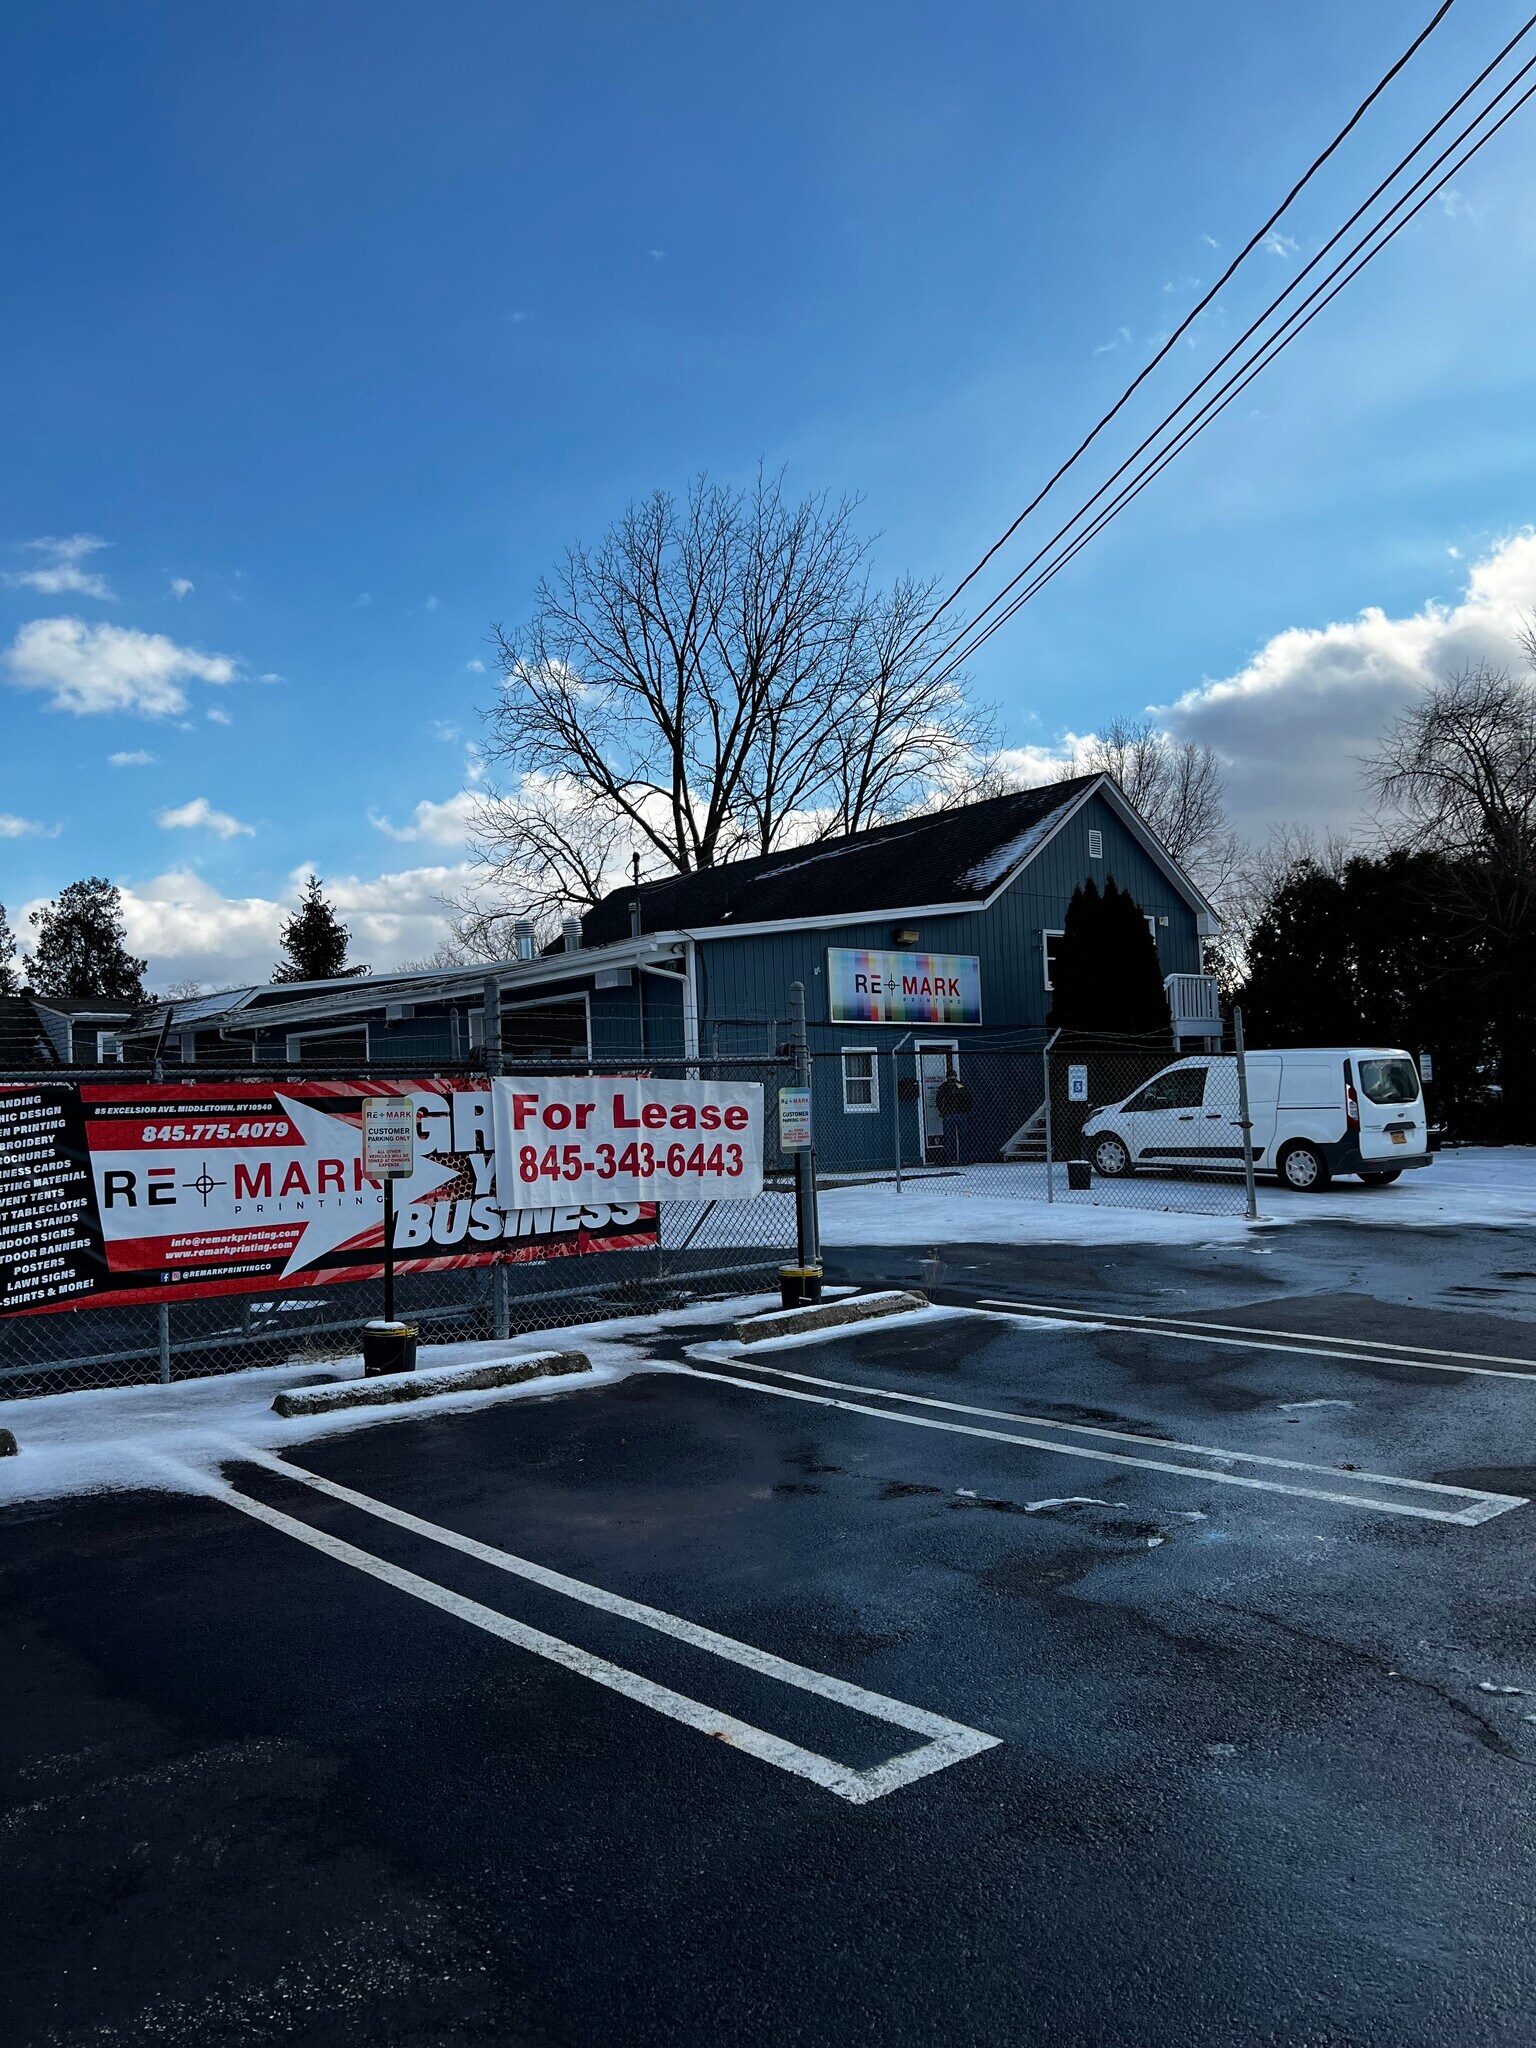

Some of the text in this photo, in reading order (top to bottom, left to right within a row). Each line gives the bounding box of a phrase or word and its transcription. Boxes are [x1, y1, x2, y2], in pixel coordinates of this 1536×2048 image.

[855, 974, 960, 997] RE MARK
[20, 1106, 62, 1120] DESIGN
[95, 1107, 106, 1115] 85
[107, 1106, 157, 1115] EXCELSIOR
[157, 1105, 177, 1113] AVE.
[178, 1104, 235, 1113] MIDDLETOWN,
[248, 1103, 273, 1111] 10940
[366, 1111, 378, 1119] RE
[512, 1093, 749, 1131] For Lease
[13, 1119, 66, 1135] PRINTING
[142, 1121, 289, 1142] 845.775.4079
[368, 1127, 410, 1135] CUSTOMER
[33, 1160, 71, 1174] CARDS
[519, 1142, 743, 1183] 845-343-6443
[33, 1171, 87, 1188] MATERIAL
[104, 1158, 382, 1209] RE MARK
[30, 1188, 65, 1202] TENTS
[11, 1198, 88, 1219] TABLECLOTHS
[235, 1195, 383, 1214] PRINTING
[35, 1213, 79, 1229] STANDS
[41, 1227, 75, 1242] SIGNS
[170, 1230, 300, 1247] info@remarkprinting.com
[40, 1238, 91, 1256] BANNERS
[165, 1242, 293, 1260] www.remarkprinting.com
[14, 1257, 65, 1276] POSTERS
[182, 1263, 272, 1279] @REMARKPRINTINGCO
[7, 1269, 76, 1292] LAWN SIGNS
[47, 1287, 56, 1297] &
[59, 1278, 94, 1294] MORE!
